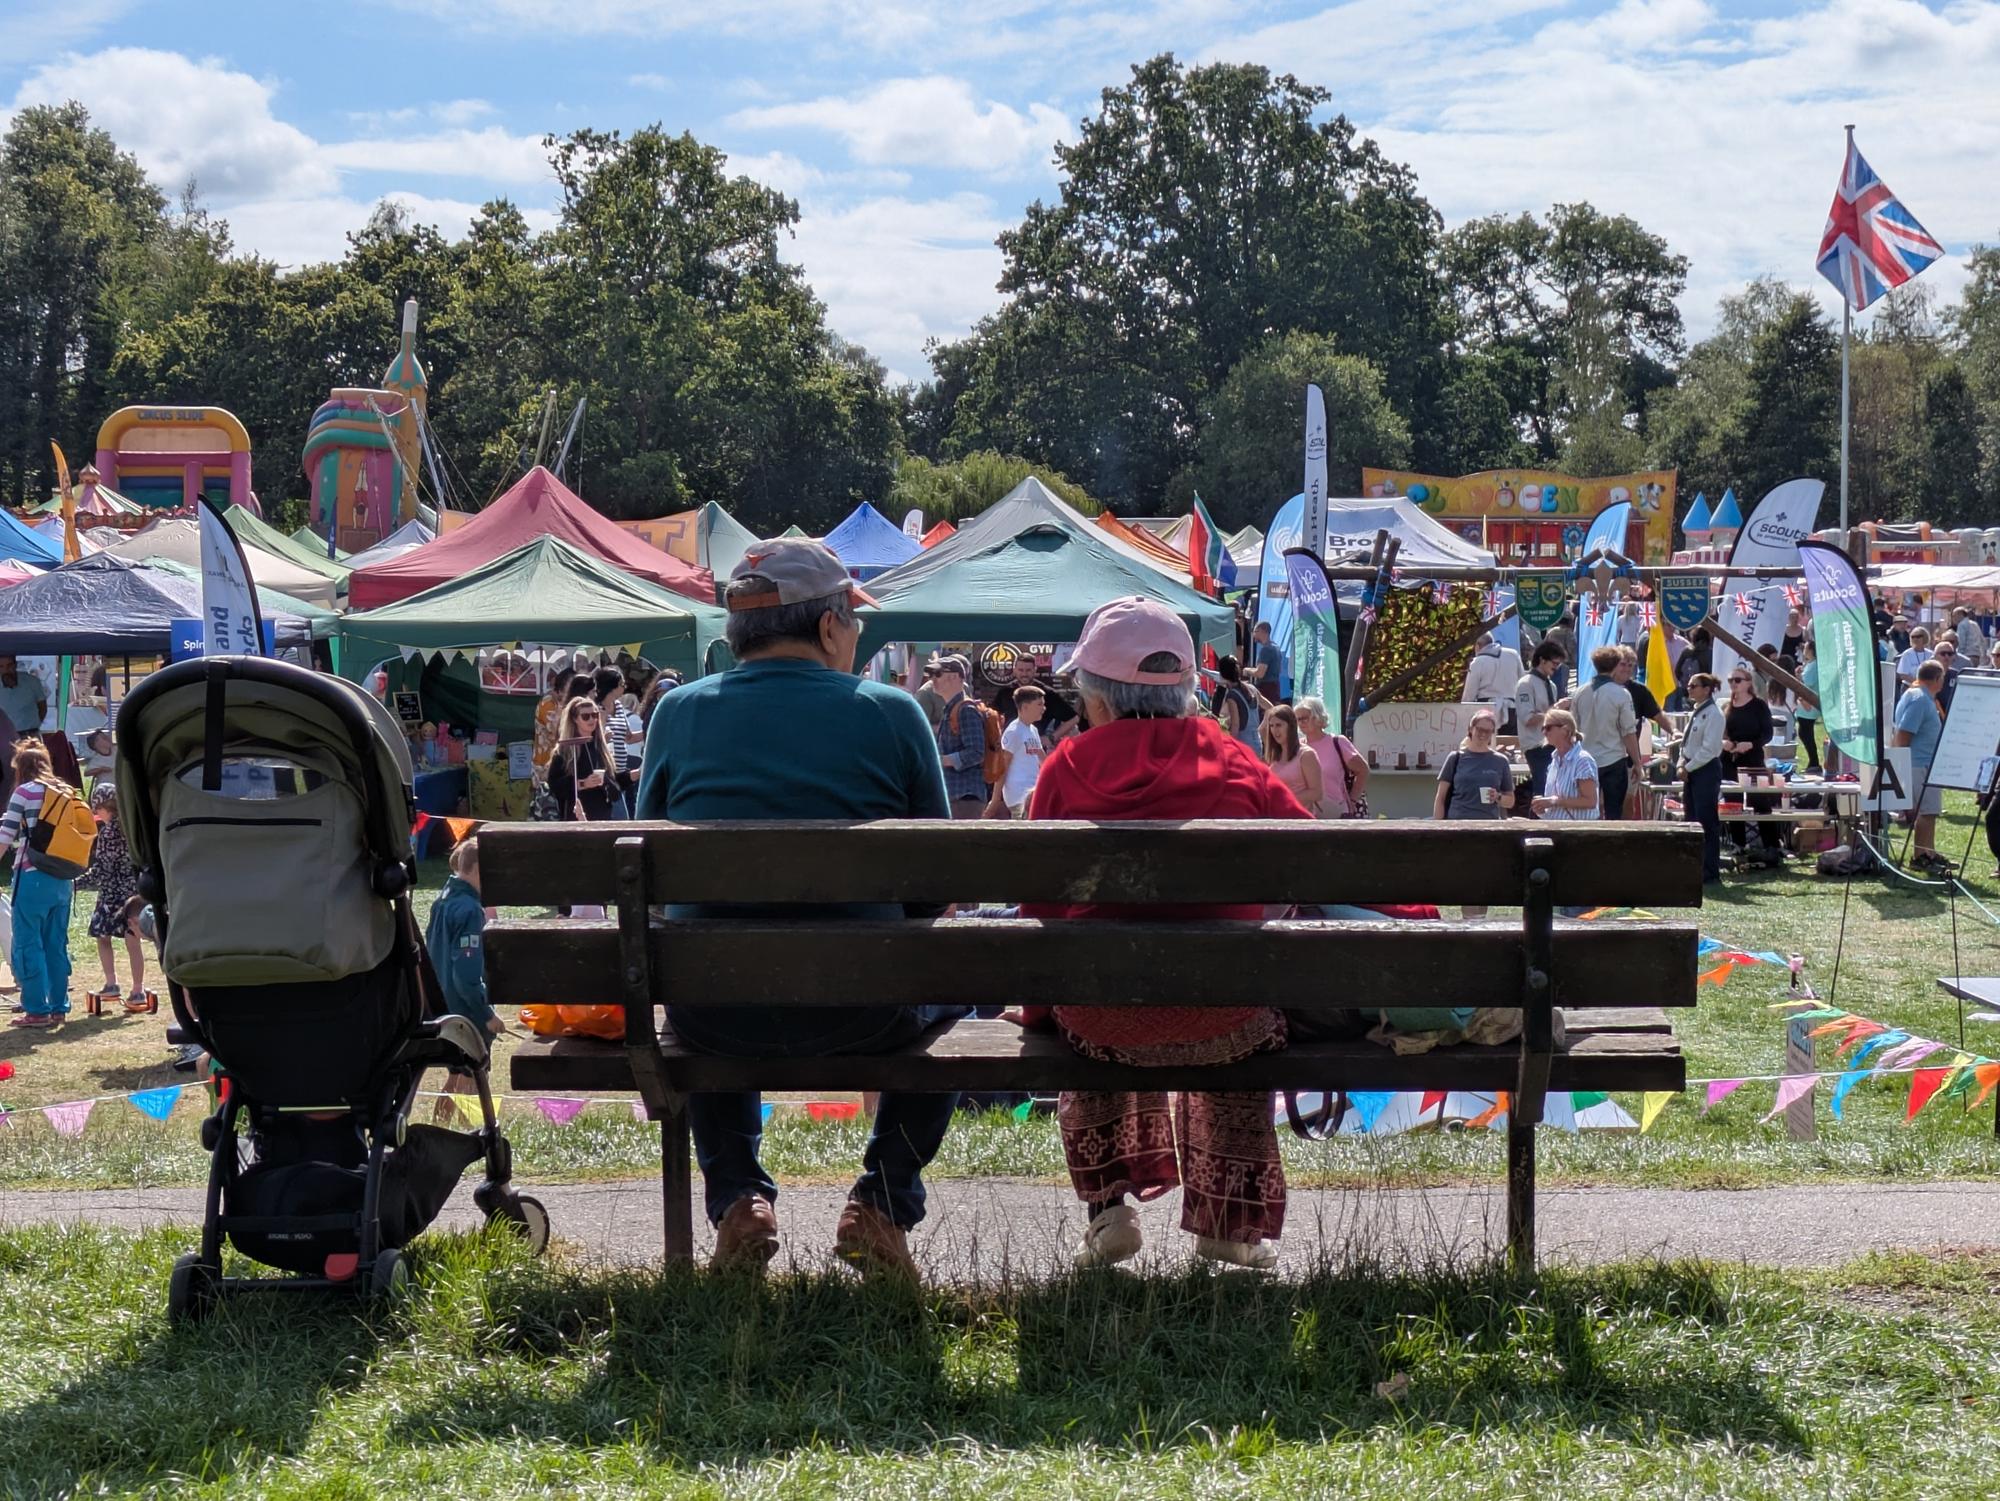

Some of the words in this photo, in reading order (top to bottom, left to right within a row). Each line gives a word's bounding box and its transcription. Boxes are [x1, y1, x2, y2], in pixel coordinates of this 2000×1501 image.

[1760, 523, 1808, 541] scouts
[1666, 578, 1704, 588] SUSSEX
[210, 606, 230, 651] and
[1370, 706, 1457, 734] HOOPLA
[1868, 758, 1906, 801] A
